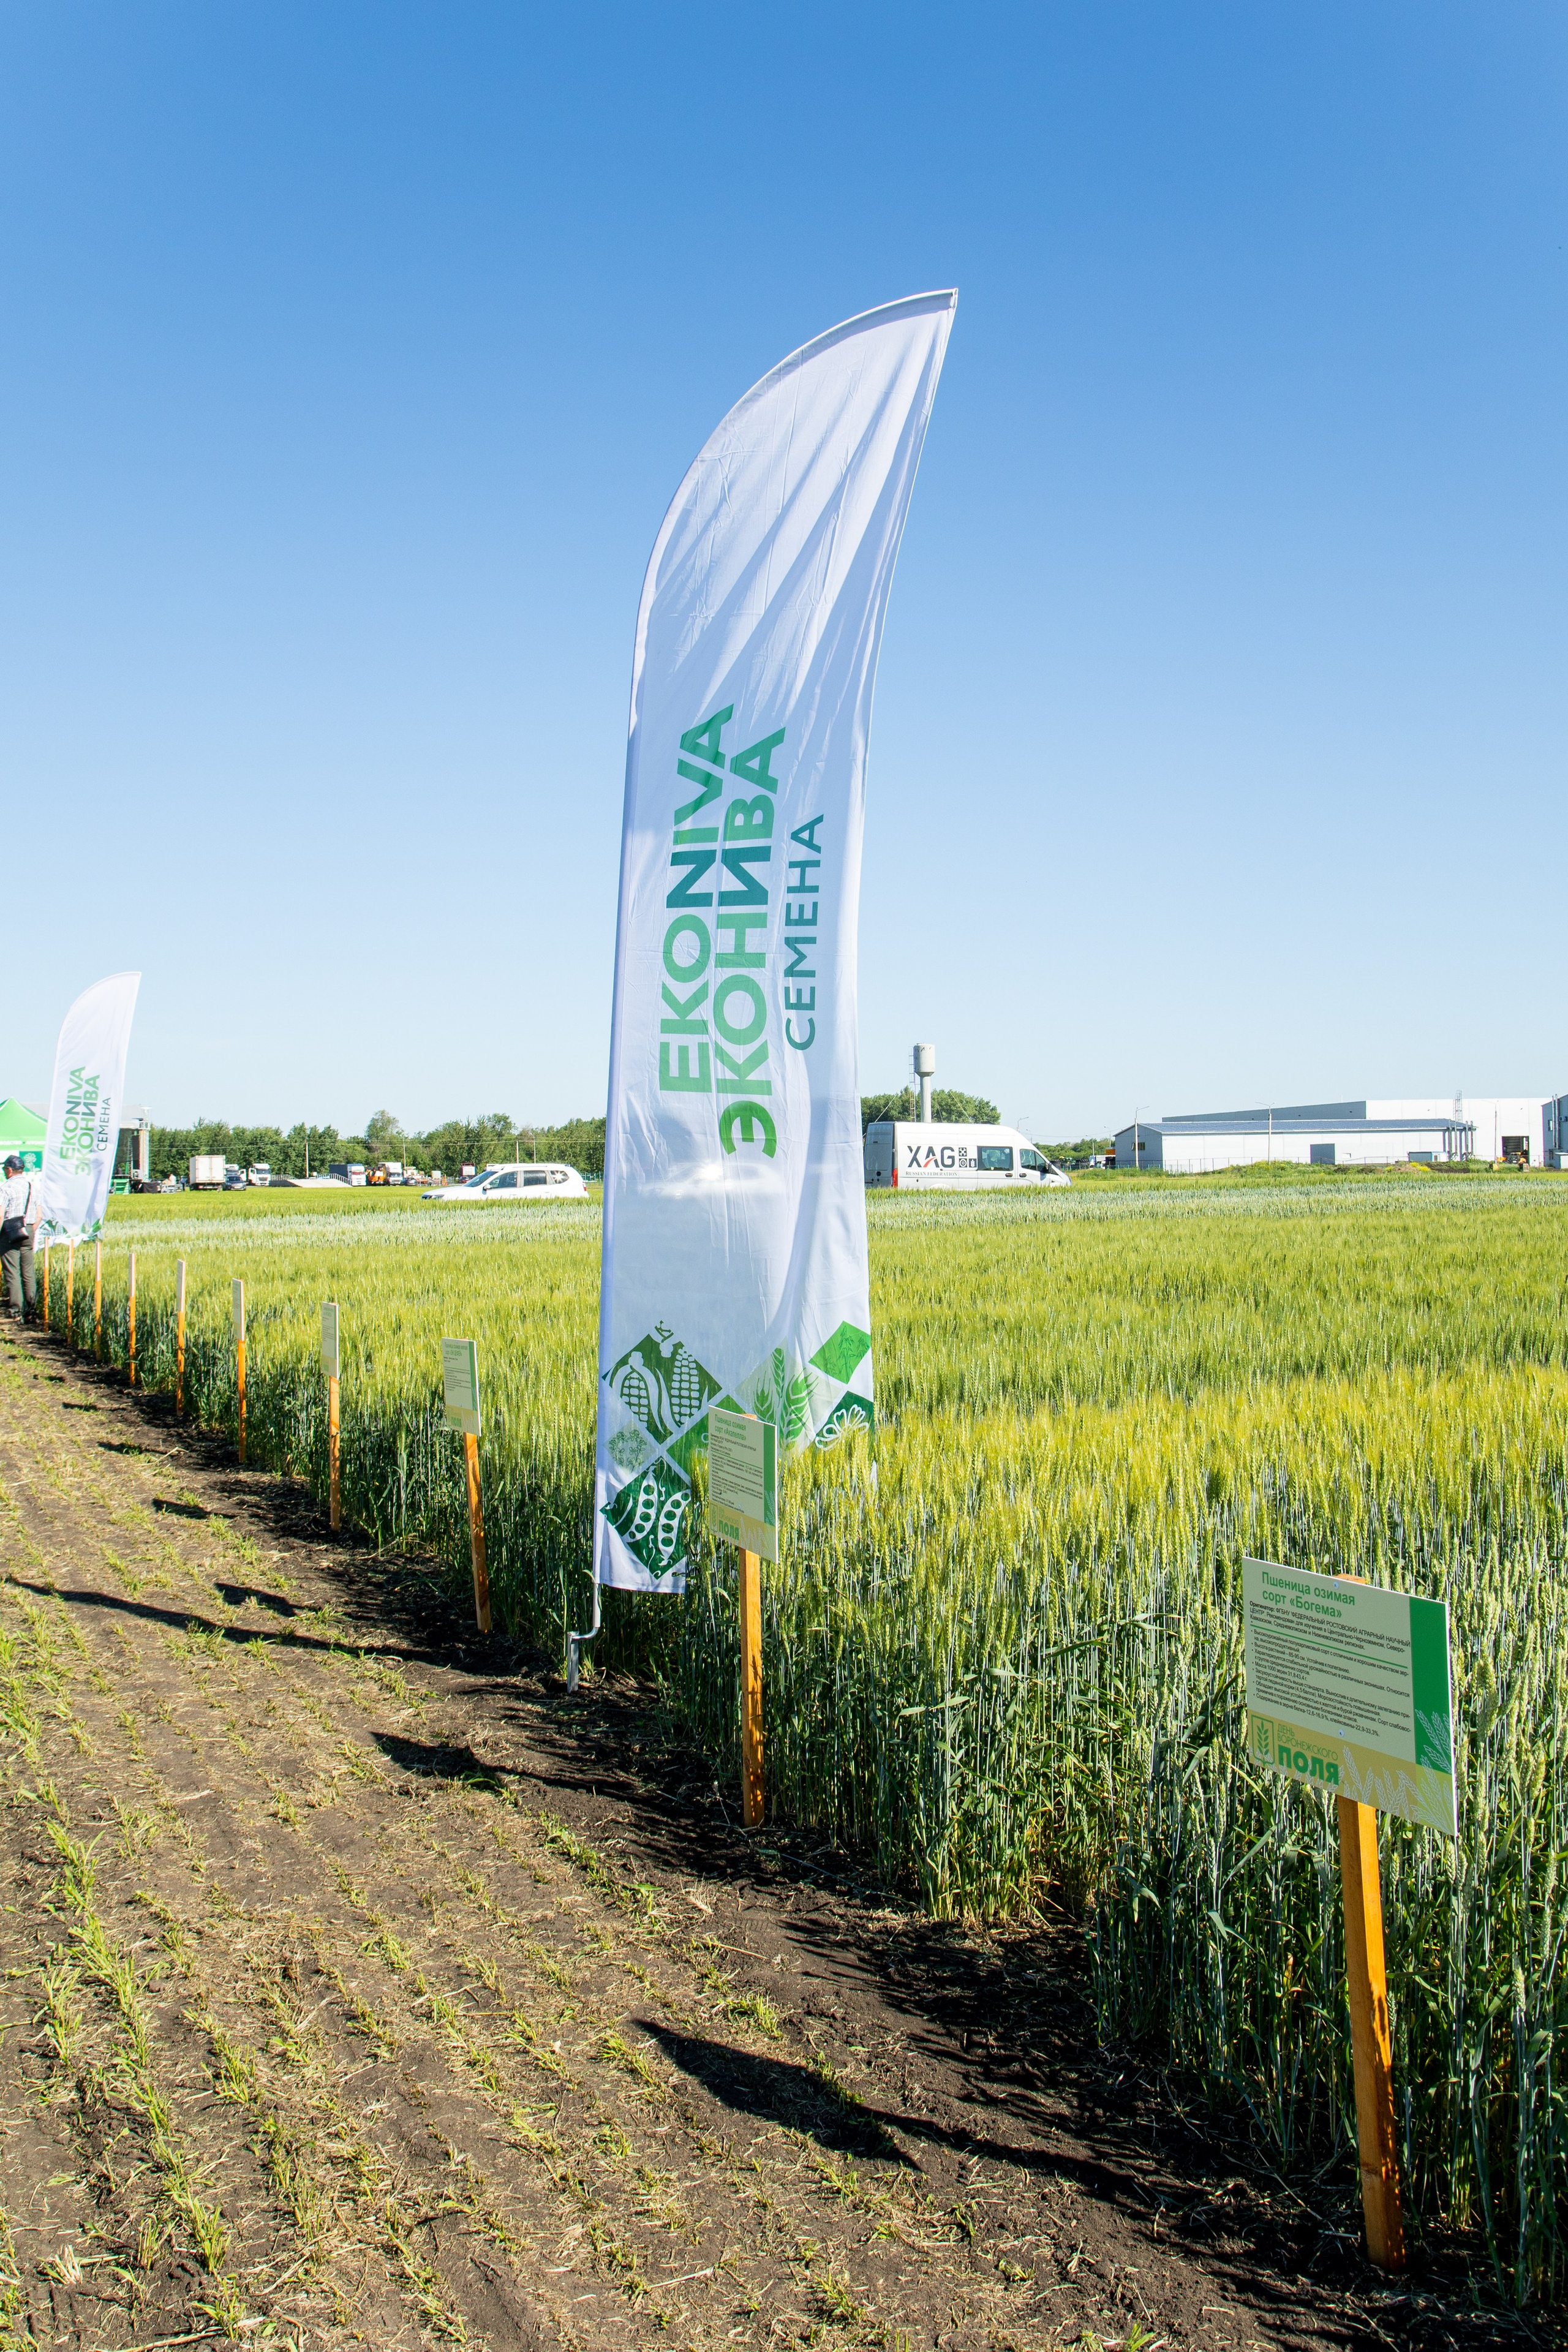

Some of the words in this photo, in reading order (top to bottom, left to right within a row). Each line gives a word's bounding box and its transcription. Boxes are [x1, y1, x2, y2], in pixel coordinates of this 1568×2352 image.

[660, 703, 734, 1093] EKONIVA
[713, 726, 786, 1159] ЭКОНИВА
[785, 813, 824, 1051] СЕМЕНА
[60, 1066, 86, 1159] EKONIVA
[75, 1074, 100, 1176] ЭКОНИВА
[96, 1097, 111, 1152] СЕМЕНА
[907, 1145, 956, 1168] XAG
[719, 1520, 739, 1540] ПОЛЯ
[1262, 1571, 1311, 1595] Пшеница
[1314, 1588, 1355, 1605] озимая
[1262, 1591, 1286, 1605] сорт
[1290, 1596, 1342, 1618] «Богема»
[1278, 1724, 1295, 1736] ДЕНЬ
[1278, 1733, 1338, 1761] ВОРОНЕЖСКОГО
[1278, 1745, 1339, 1785] ПОЛЯ
